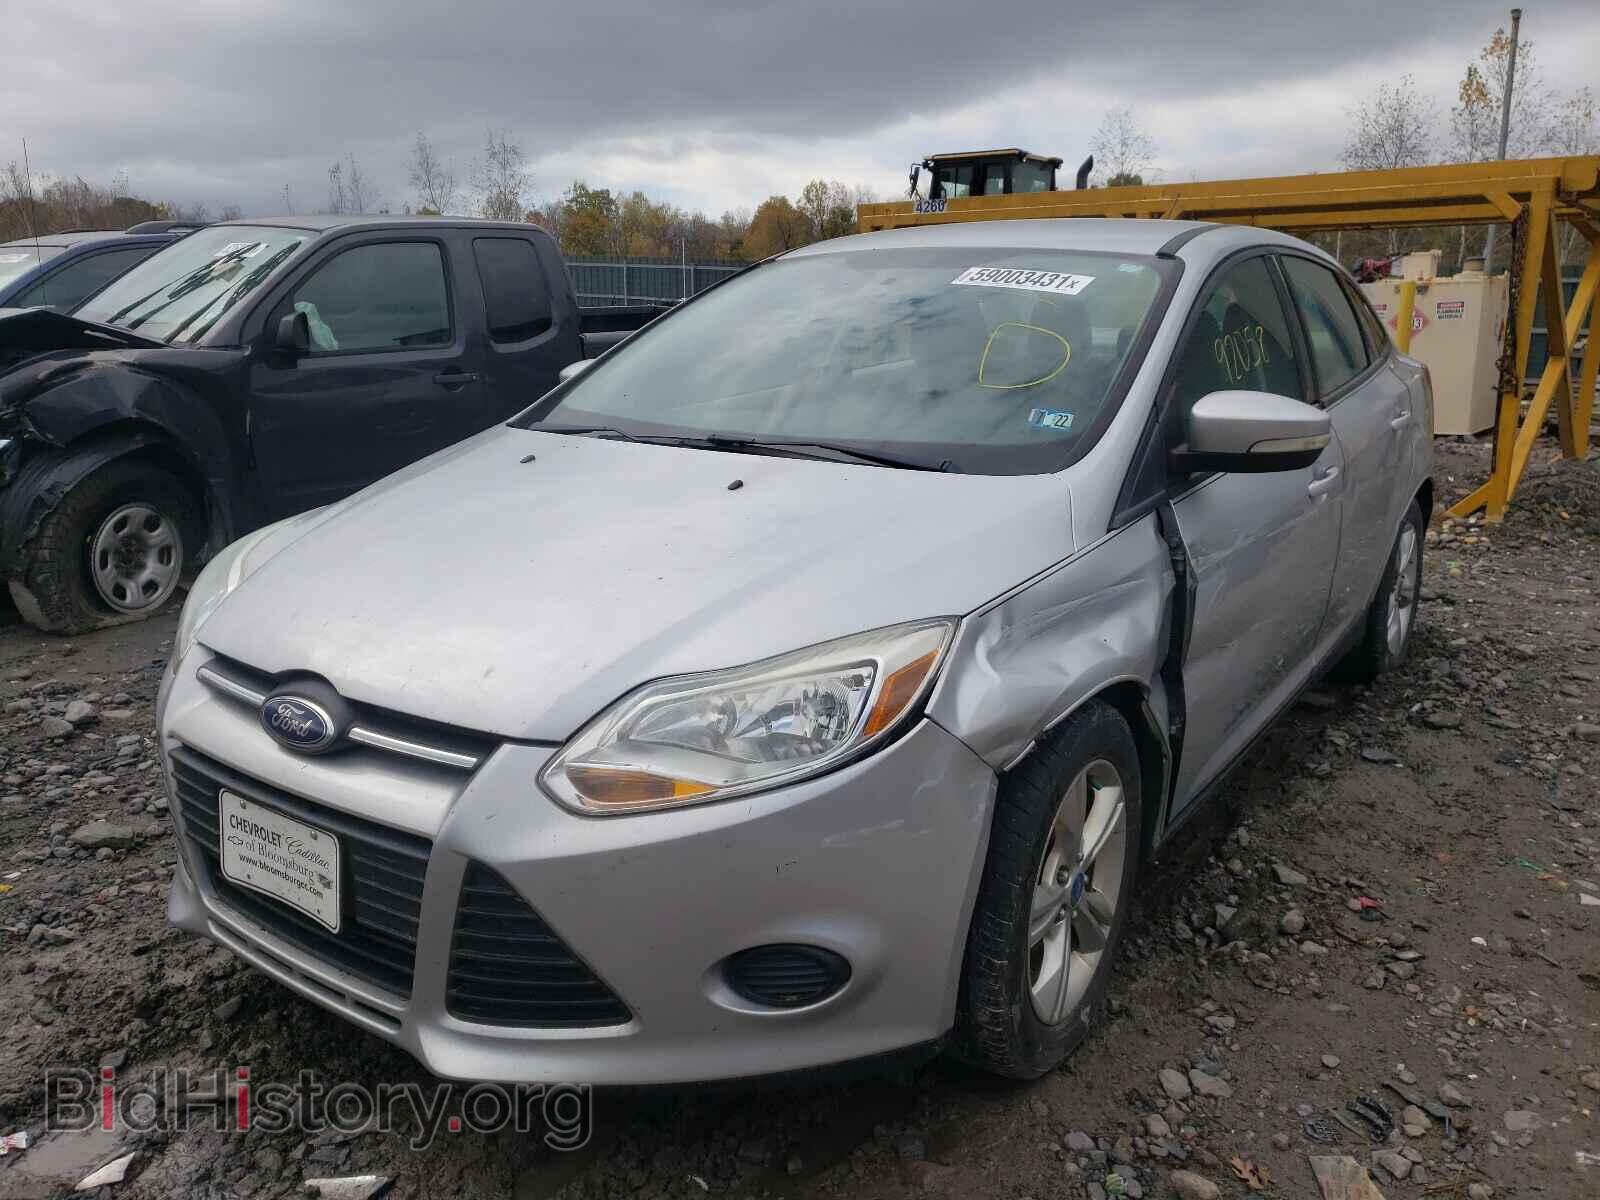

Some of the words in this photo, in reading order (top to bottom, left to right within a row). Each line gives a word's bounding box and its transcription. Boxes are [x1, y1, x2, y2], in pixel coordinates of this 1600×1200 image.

[271, 703, 313, 737] Ford
[229, 814, 282, 848] CHEVROLET
[285, 836, 329, 870] Cadillac
[245, 839, 256, 852] of
[258, 842, 315, 886] Bloomsburg
